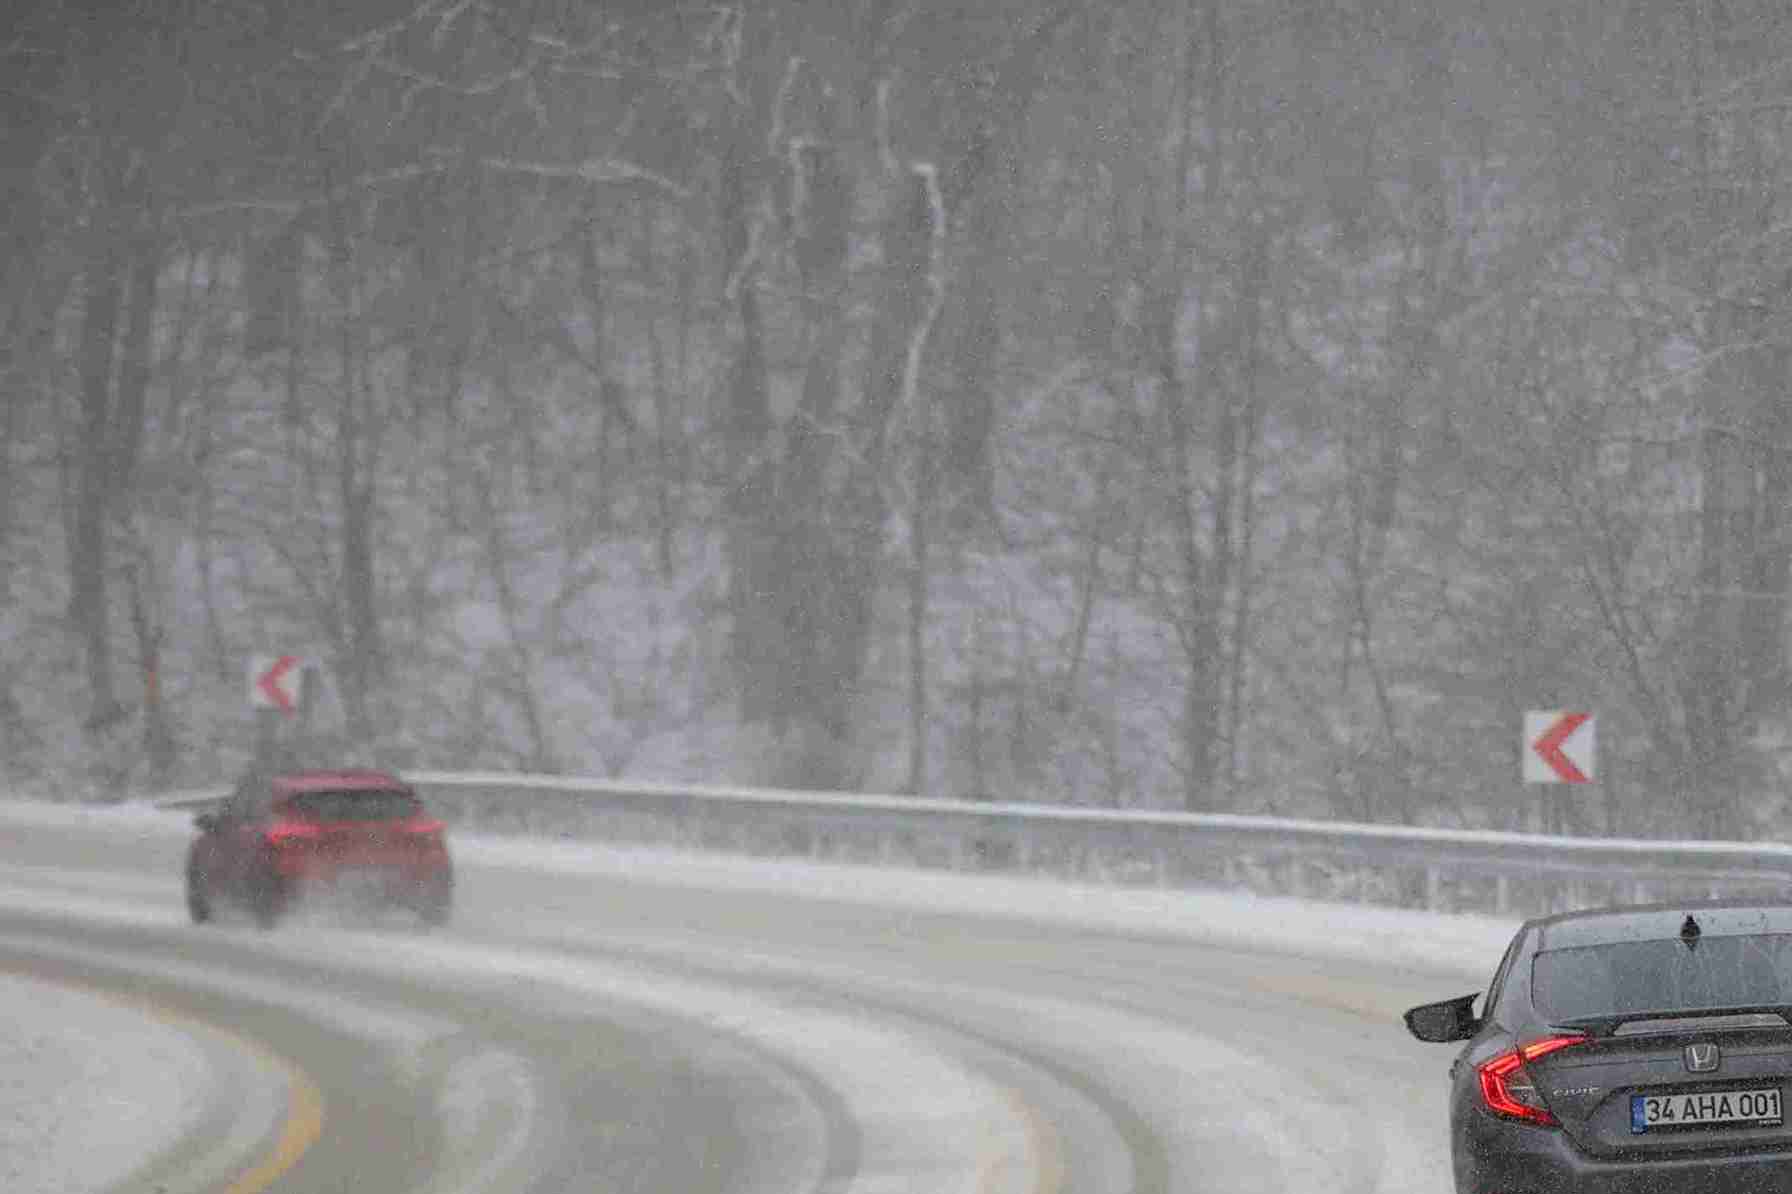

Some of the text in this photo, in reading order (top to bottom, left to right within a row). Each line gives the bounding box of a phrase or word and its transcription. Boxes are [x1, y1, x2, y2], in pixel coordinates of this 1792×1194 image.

[1646, 1092, 1778, 1122] 34 AHA 001
